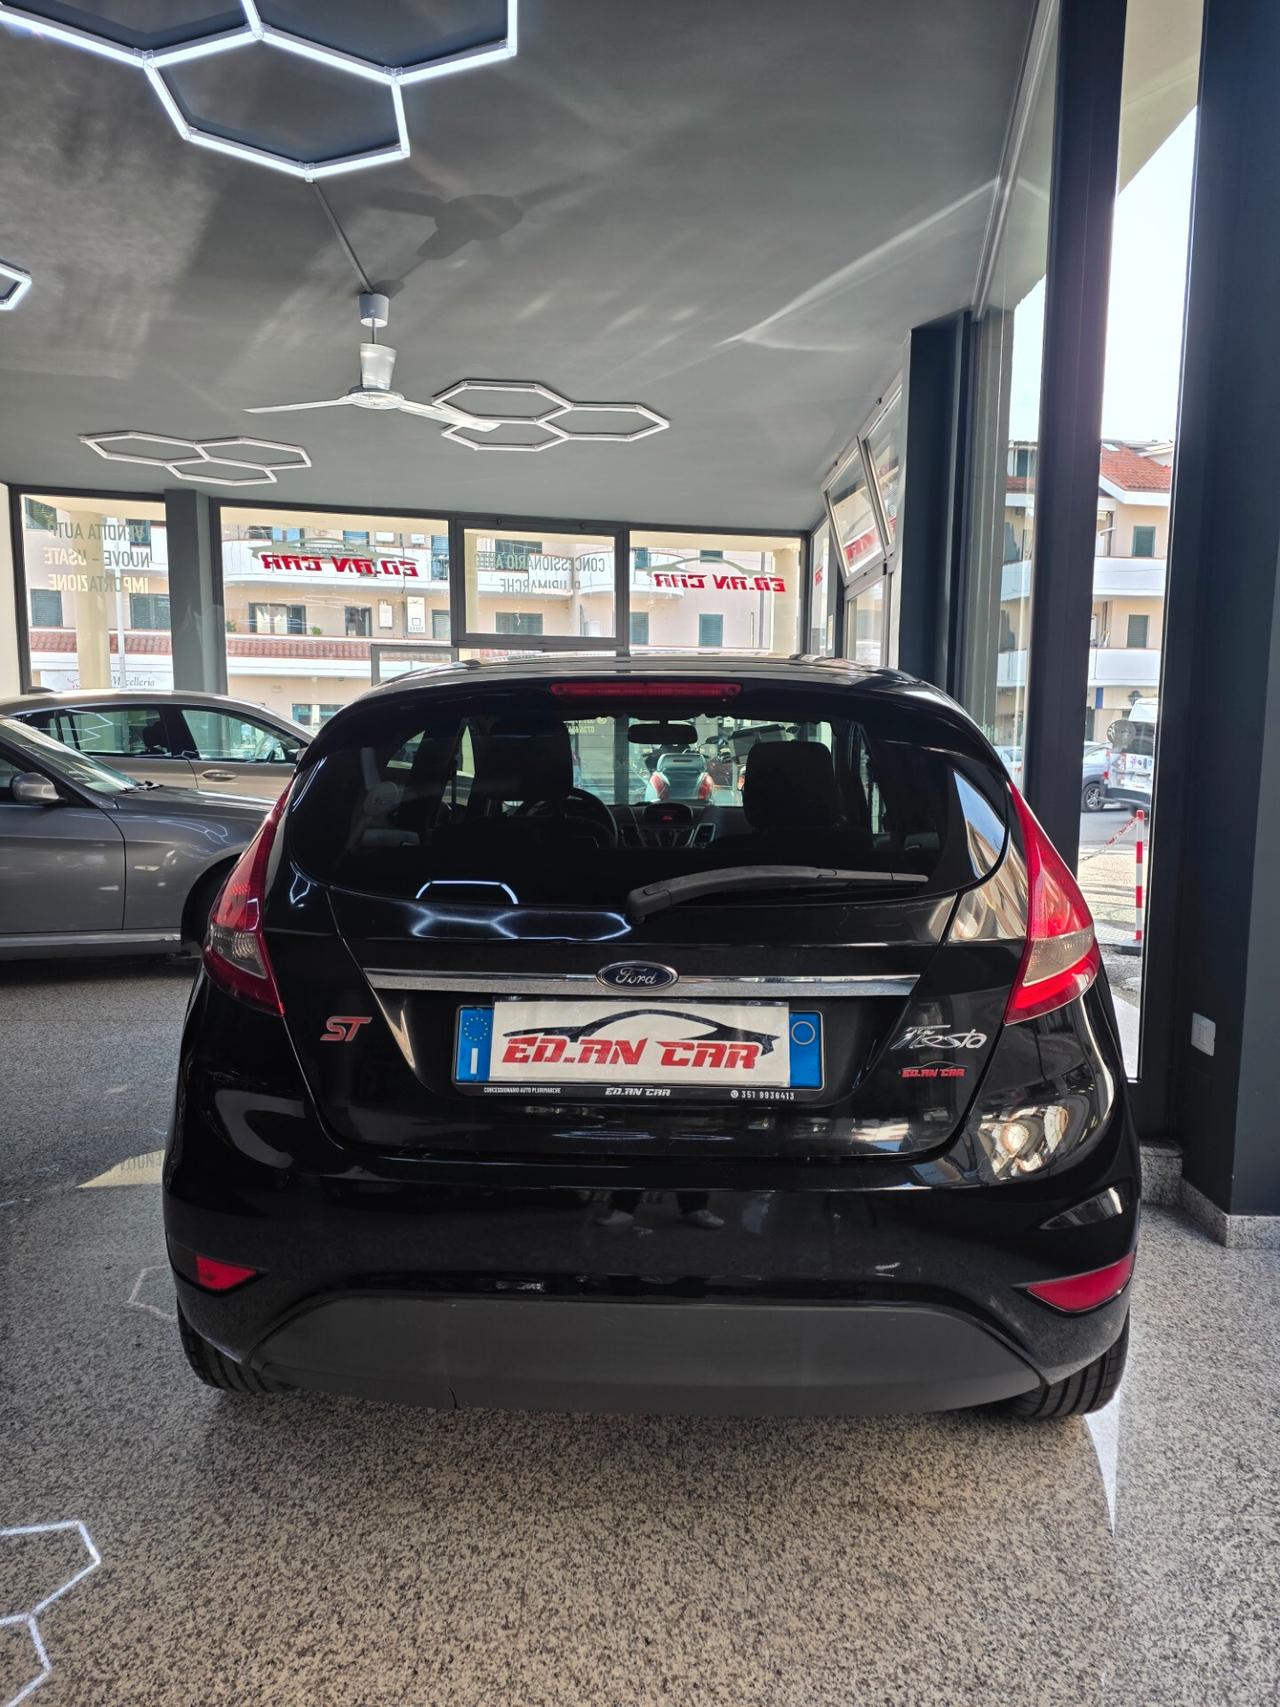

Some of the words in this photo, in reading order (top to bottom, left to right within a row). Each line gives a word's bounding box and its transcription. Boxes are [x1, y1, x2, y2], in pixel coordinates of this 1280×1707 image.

[112, 675, 155, 687] Mcelleria
[615, 966, 657, 986] Ford
[320, 1015, 372, 1042] ST
[502, 1036, 648, 1066] ED.AN
[656, 1040, 762, 1070] CAR
[605, 1087, 643, 1096] ED.AN
[644, 1088, 671, 1097] CAR
